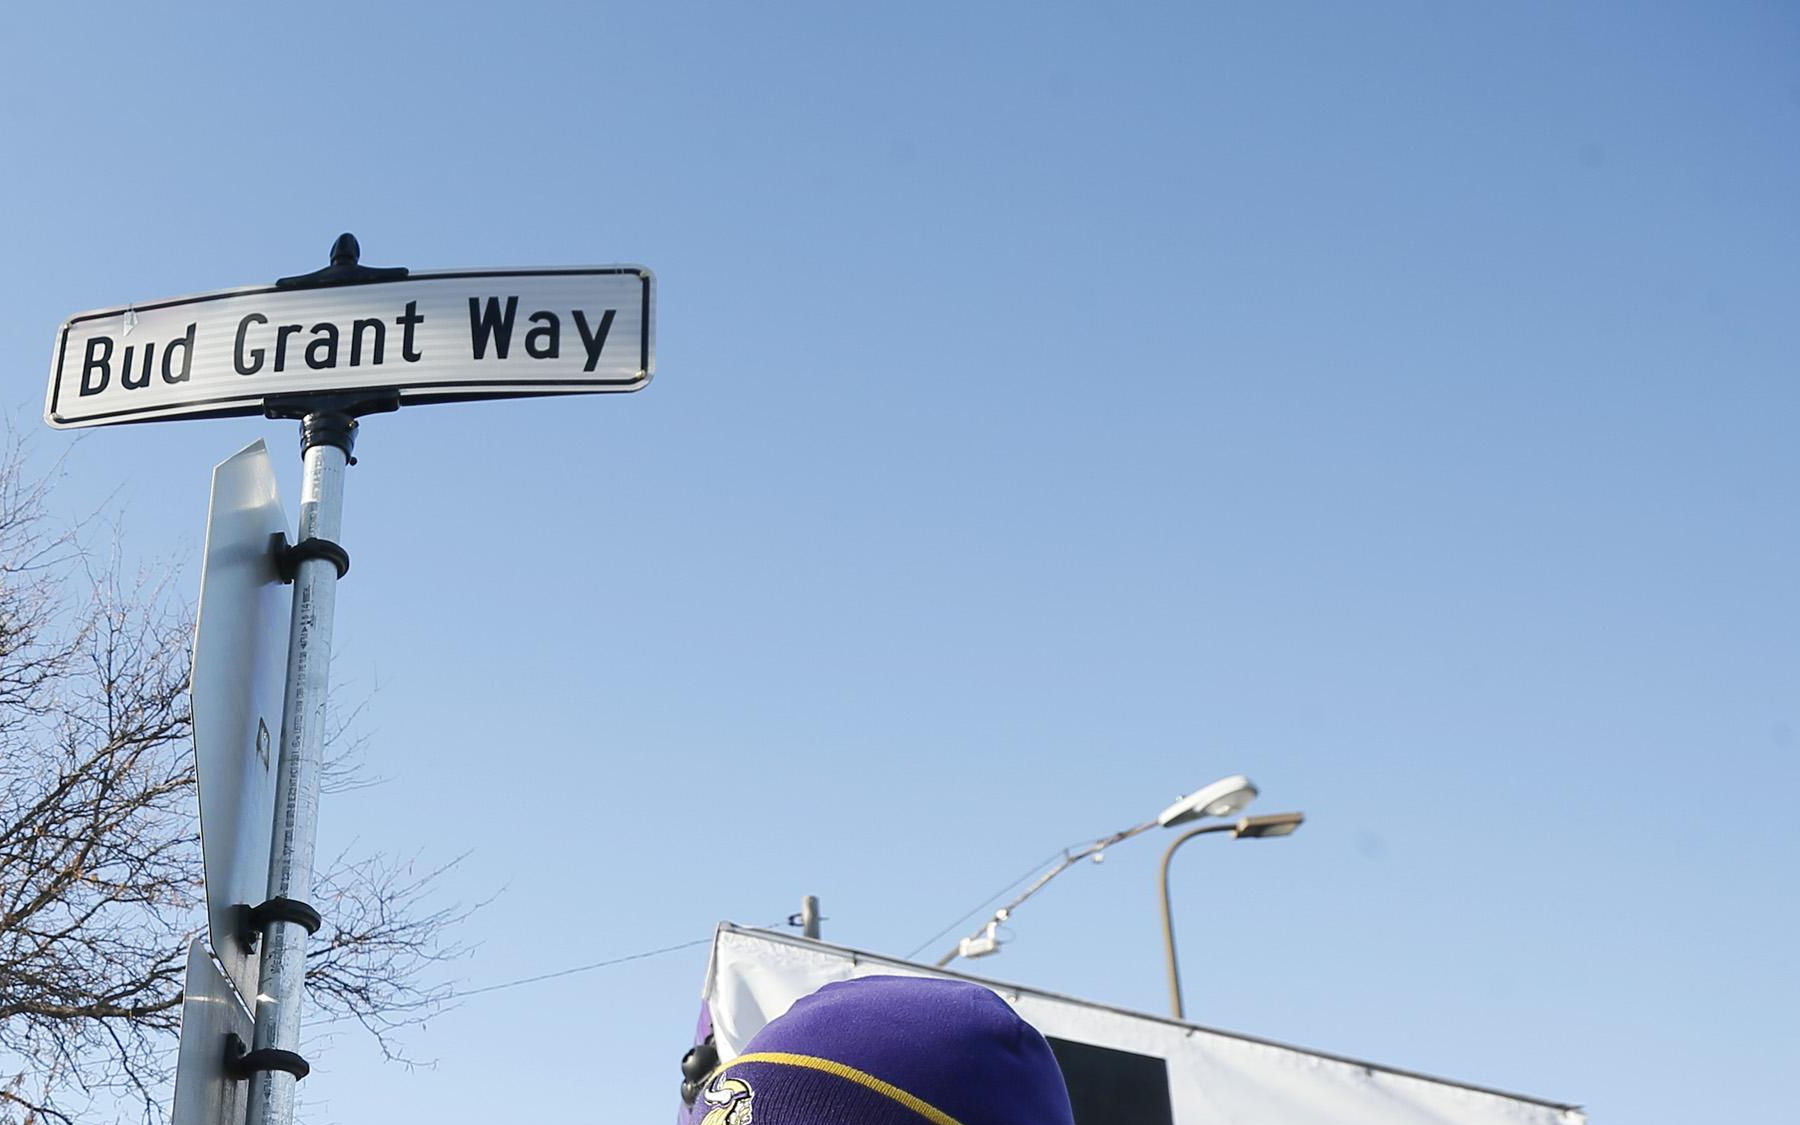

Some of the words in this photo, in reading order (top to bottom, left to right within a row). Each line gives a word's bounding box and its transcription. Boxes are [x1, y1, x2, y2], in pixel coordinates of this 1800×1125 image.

[79, 321, 197, 397] Bud
[233, 300, 425, 377] Grant
[468, 295, 617, 372] Way
